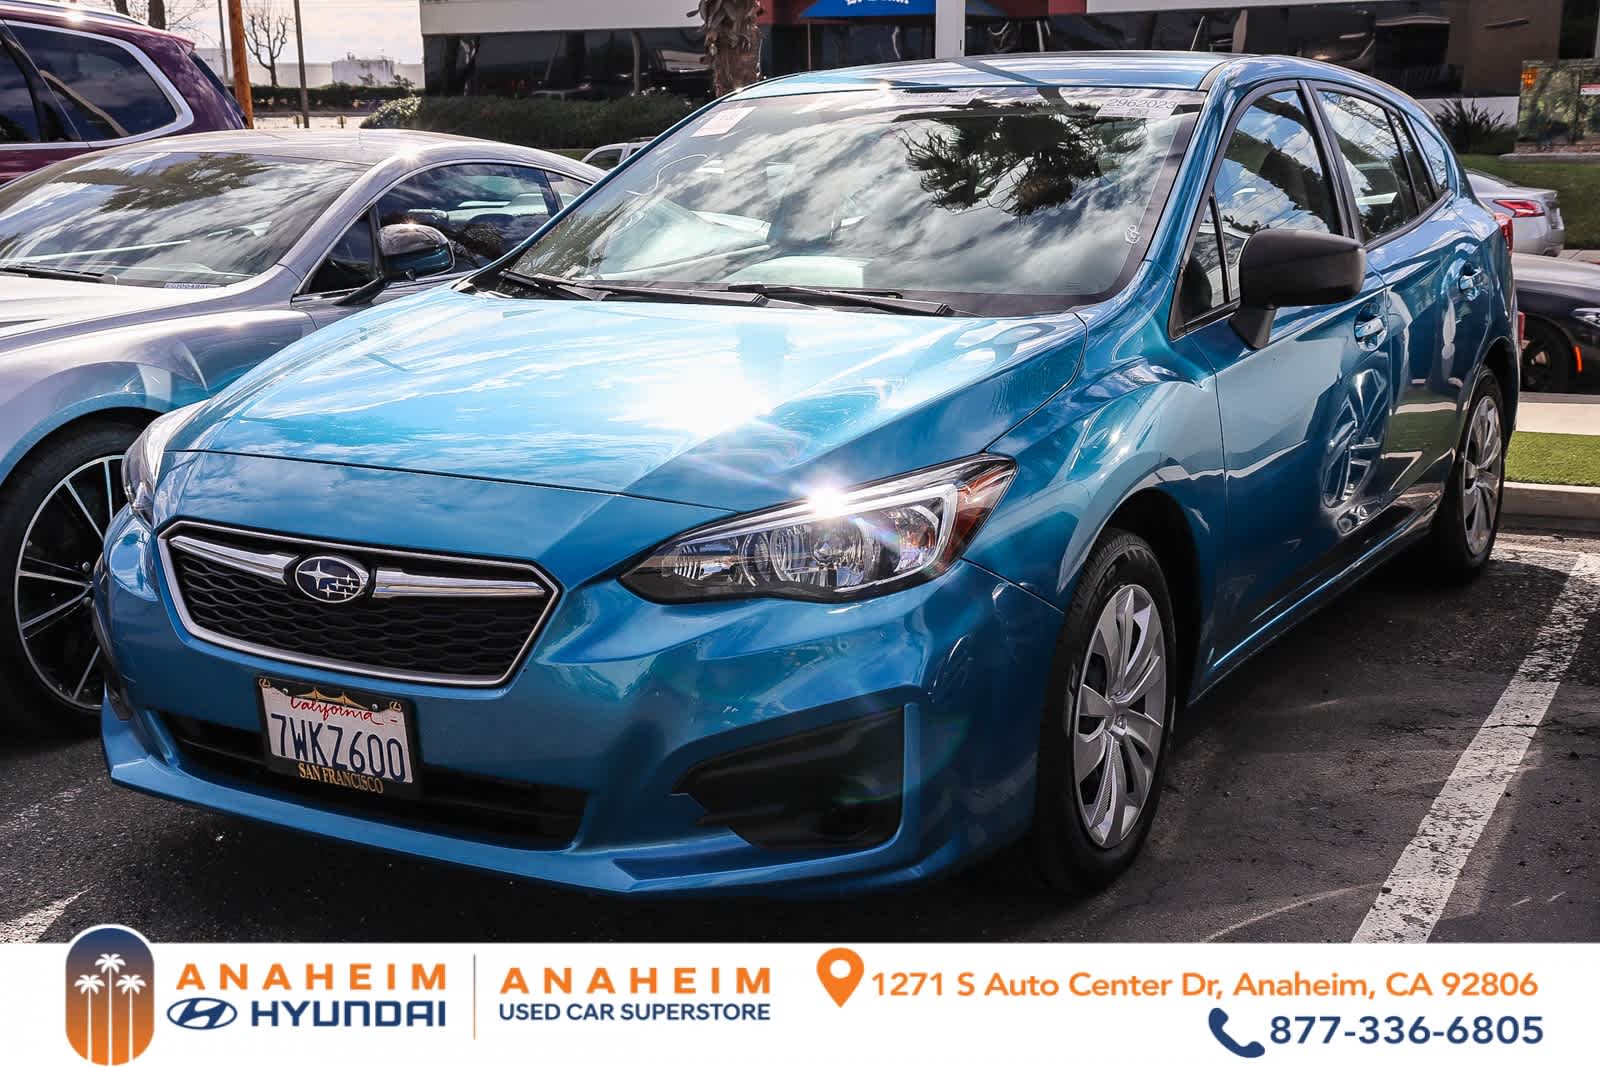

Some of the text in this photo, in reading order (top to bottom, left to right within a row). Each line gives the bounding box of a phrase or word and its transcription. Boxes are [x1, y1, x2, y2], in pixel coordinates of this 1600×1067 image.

[271, 713, 406, 782] 7WKZ600
[297, 763, 384, 794] SAN FRANCISCO
